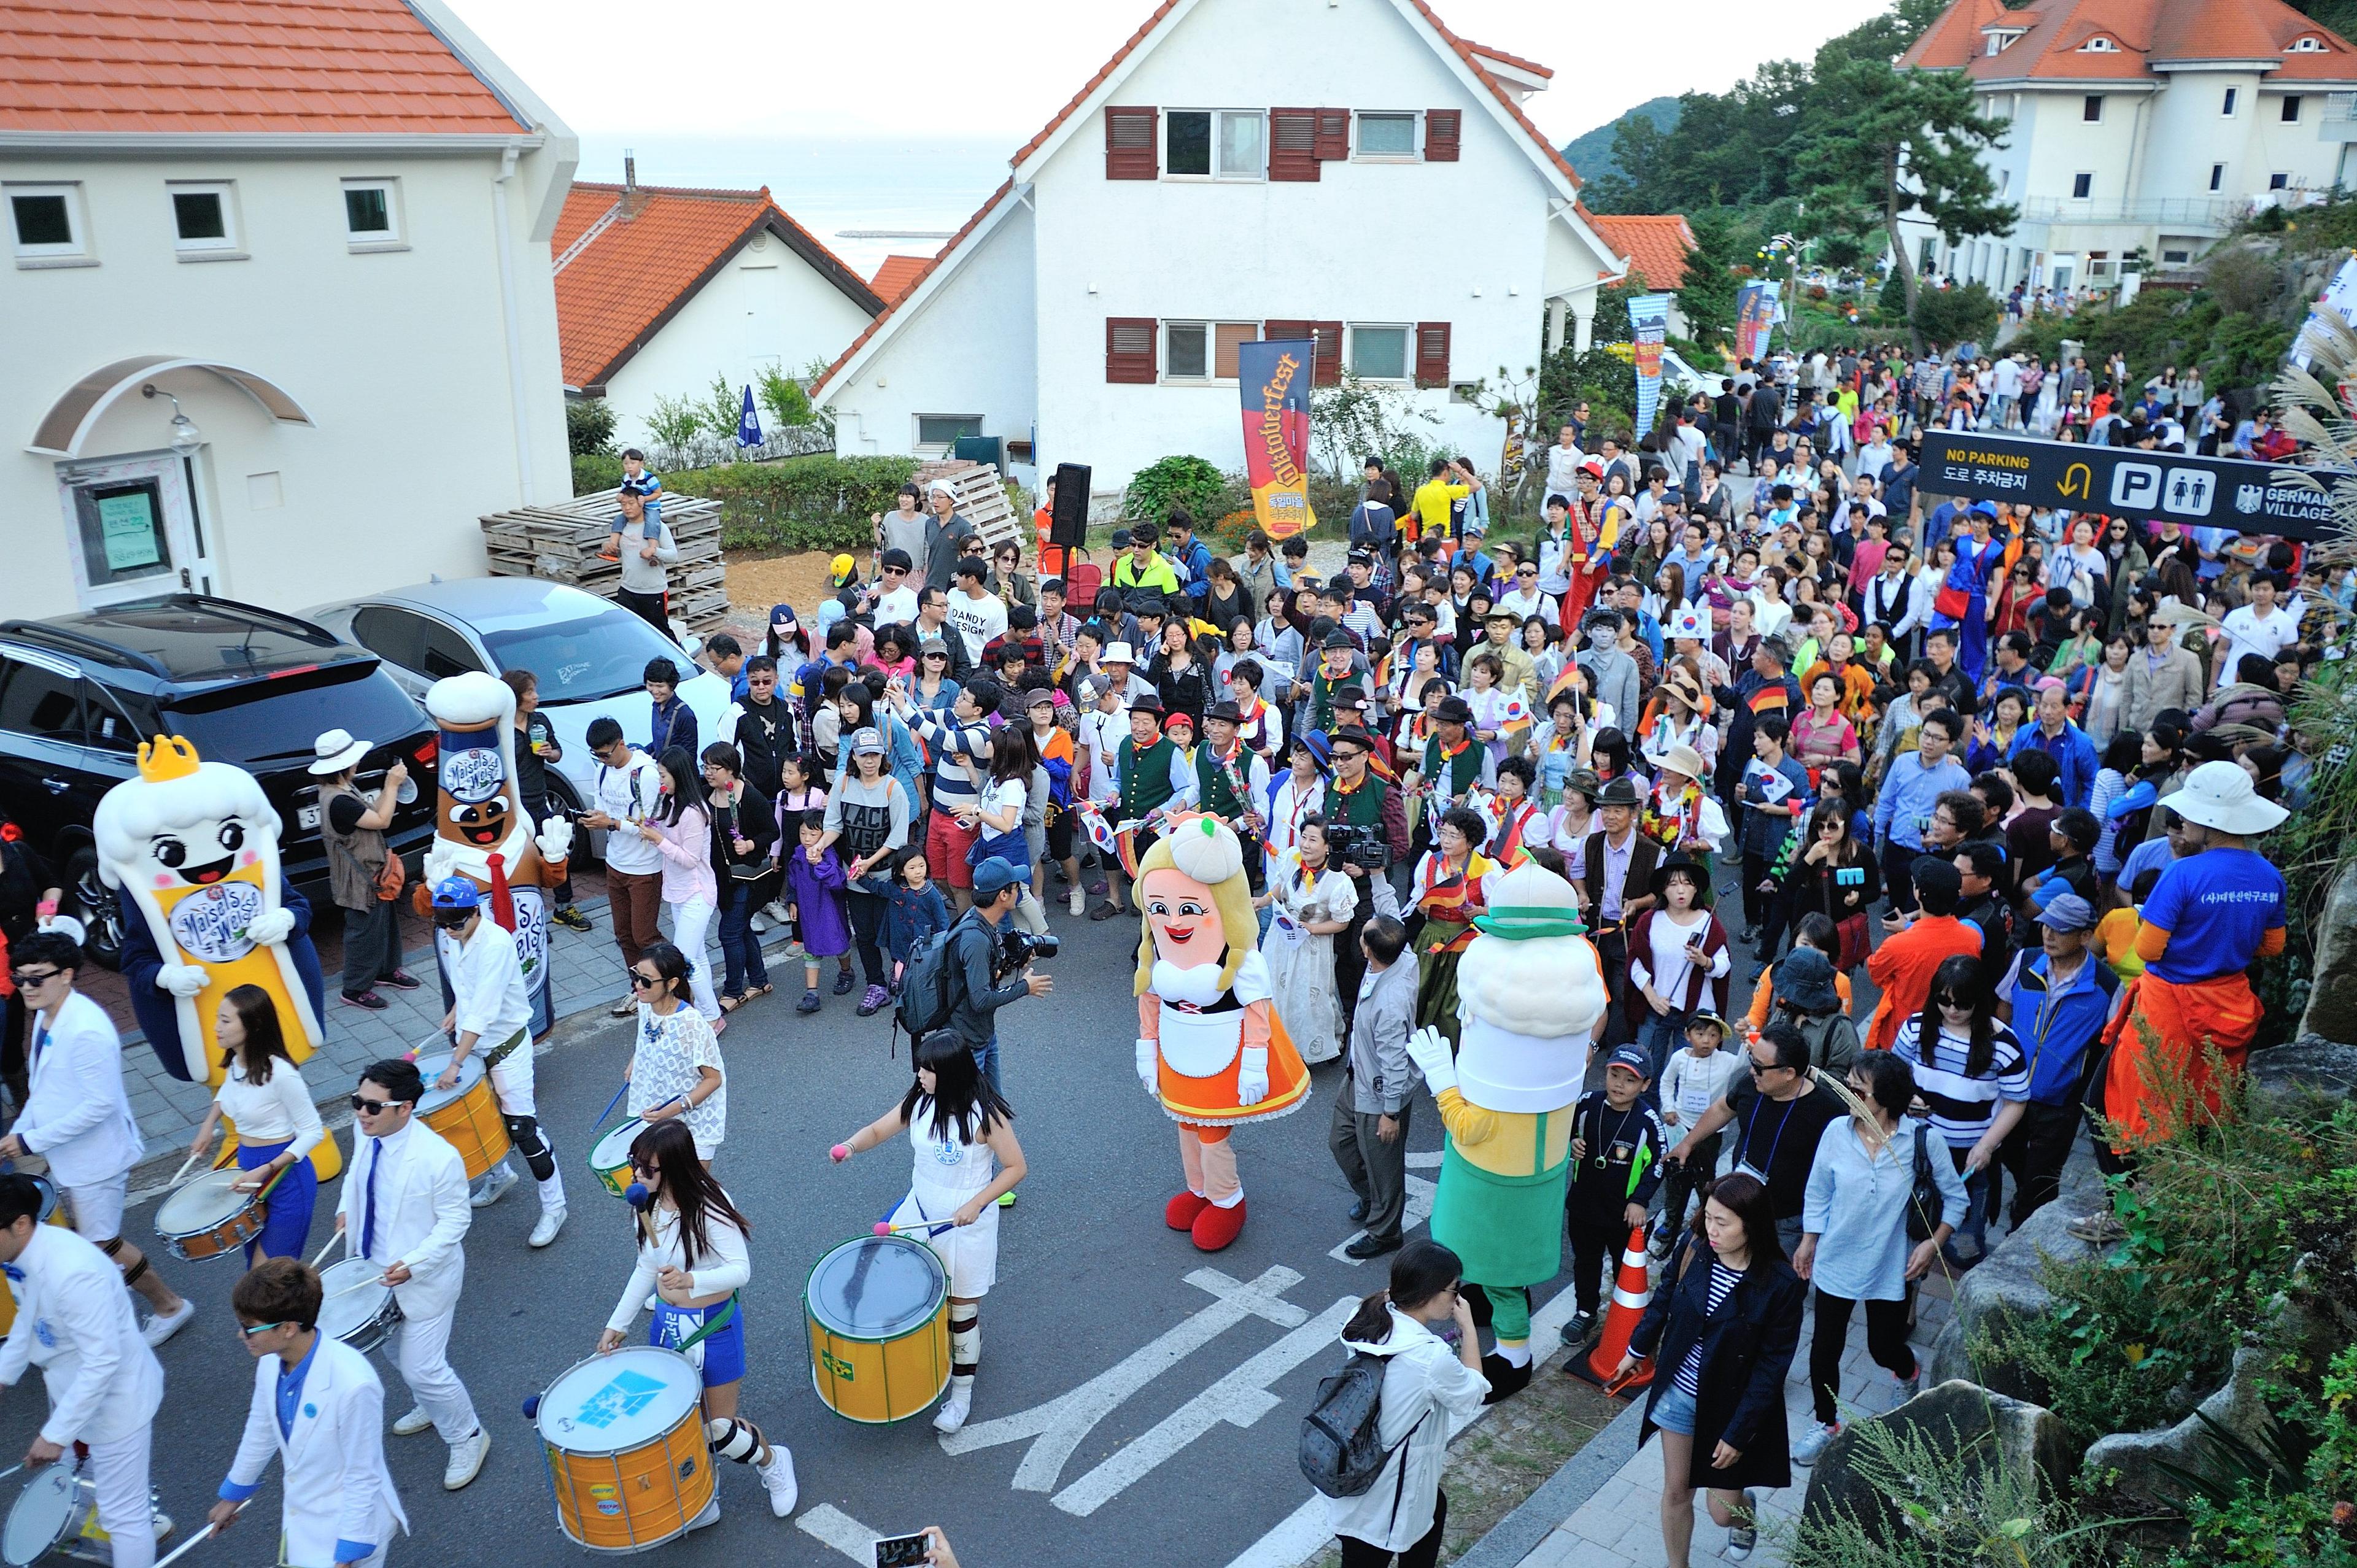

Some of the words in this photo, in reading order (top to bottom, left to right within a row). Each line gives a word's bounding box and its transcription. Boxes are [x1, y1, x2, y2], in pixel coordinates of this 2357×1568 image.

[1258, 352, 1301, 487] Oktoberfest
[1946, 449, 1966, 462] NO
[1968, 451, 2030, 469] PARKING
[1943, 466, 1970, 482] 도로
[1973, 469, 2028, 490] 주차금지
[2122, 471, 2151, 501] P
[1269, 496, 1304, 508] 독일마을
[2266, 489, 2333, 506] GERMAN
[2266, 502, 2331, 522] VILLAGE
[953, 609, 986, 626] DANDY
